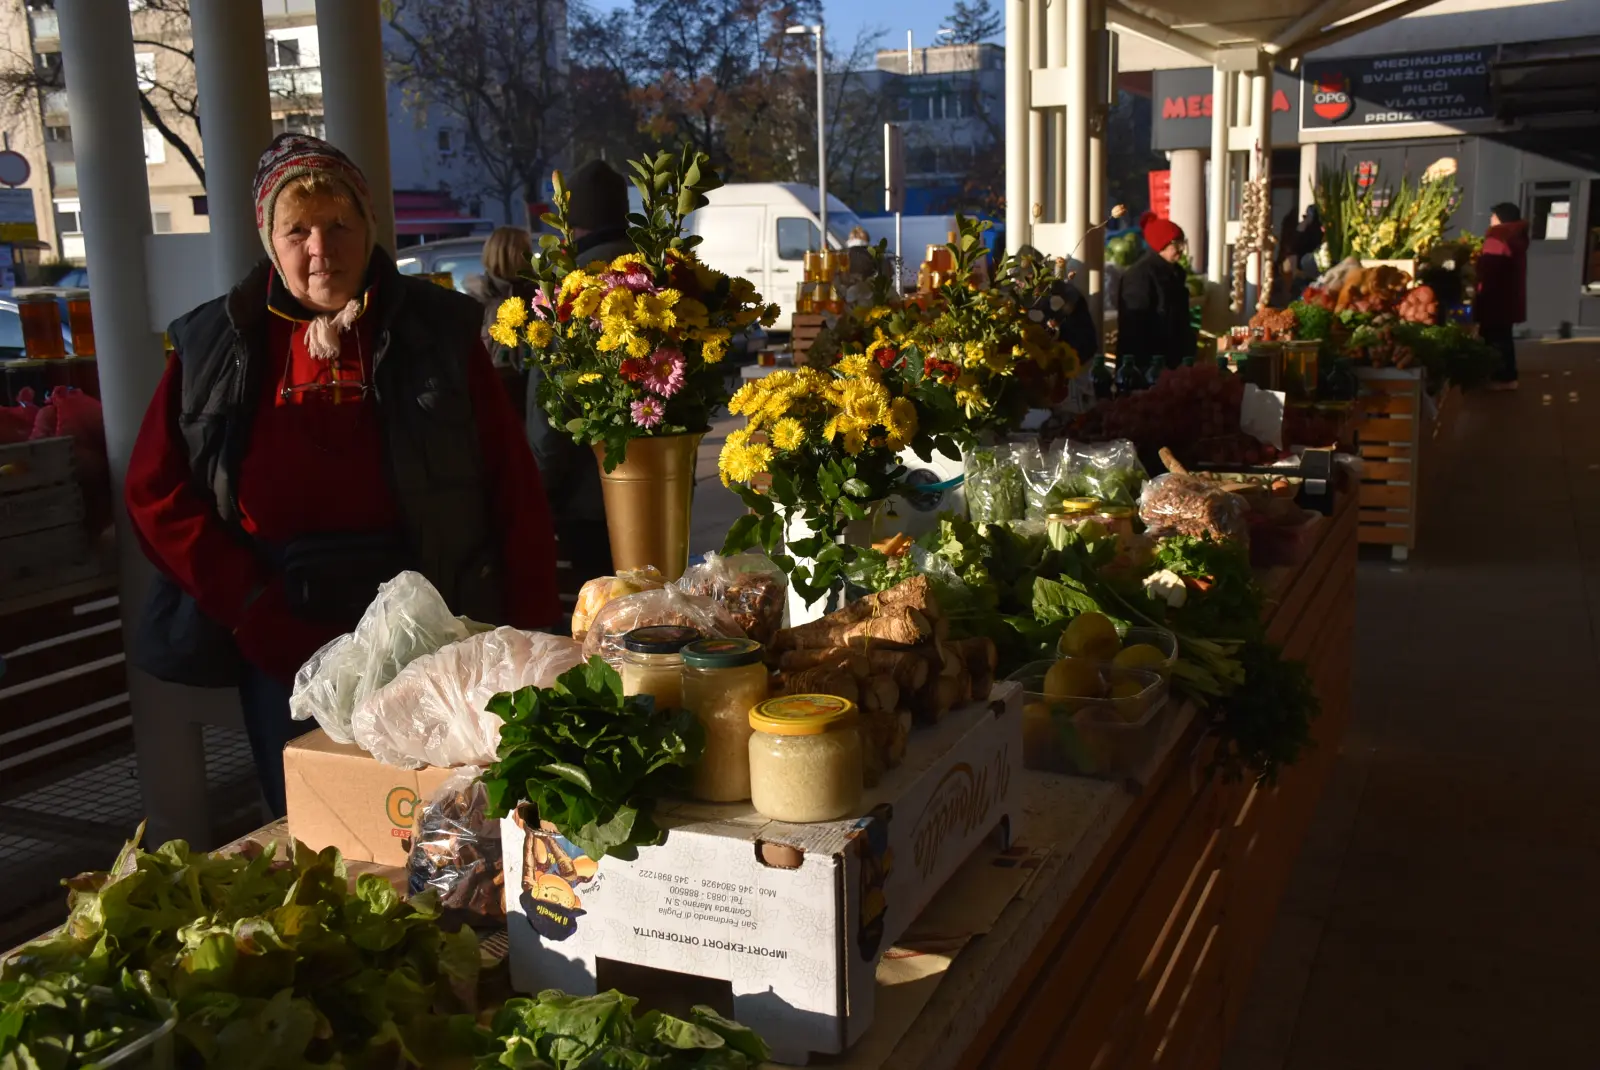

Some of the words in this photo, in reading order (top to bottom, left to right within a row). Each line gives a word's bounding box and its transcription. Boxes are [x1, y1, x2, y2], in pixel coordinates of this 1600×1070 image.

[1162, 88, 1292, 120] MESA
[1314, 91, 1348, 104] OPG
[1384, 93, 1466, 108] VLASTITA
[1364, 106, 1485, 123] PROIZVODNJA
[638, 869, 672, 882] 8981222
[674, 875, 690, 884] 345
[669, 885, 700, 898] 888500
[701, 879, 737, 892] 5804926
[738, 885, 754, 894] 346
[706, 891, 727, 902] 0883
[682, 899, 713, 912] Marano
[714, 904, 752, 918] Contrada
[658, 907, 682, 919] Puglia
[684, 911, 692, 919] di
[693, 912, 739, 927] Ferdinando
[741, 920, 758, 930] San
[633, 926, 700, 946] ORTOFRUTTA
[702, 938, 788, 960] IMPORT-EXPORT
